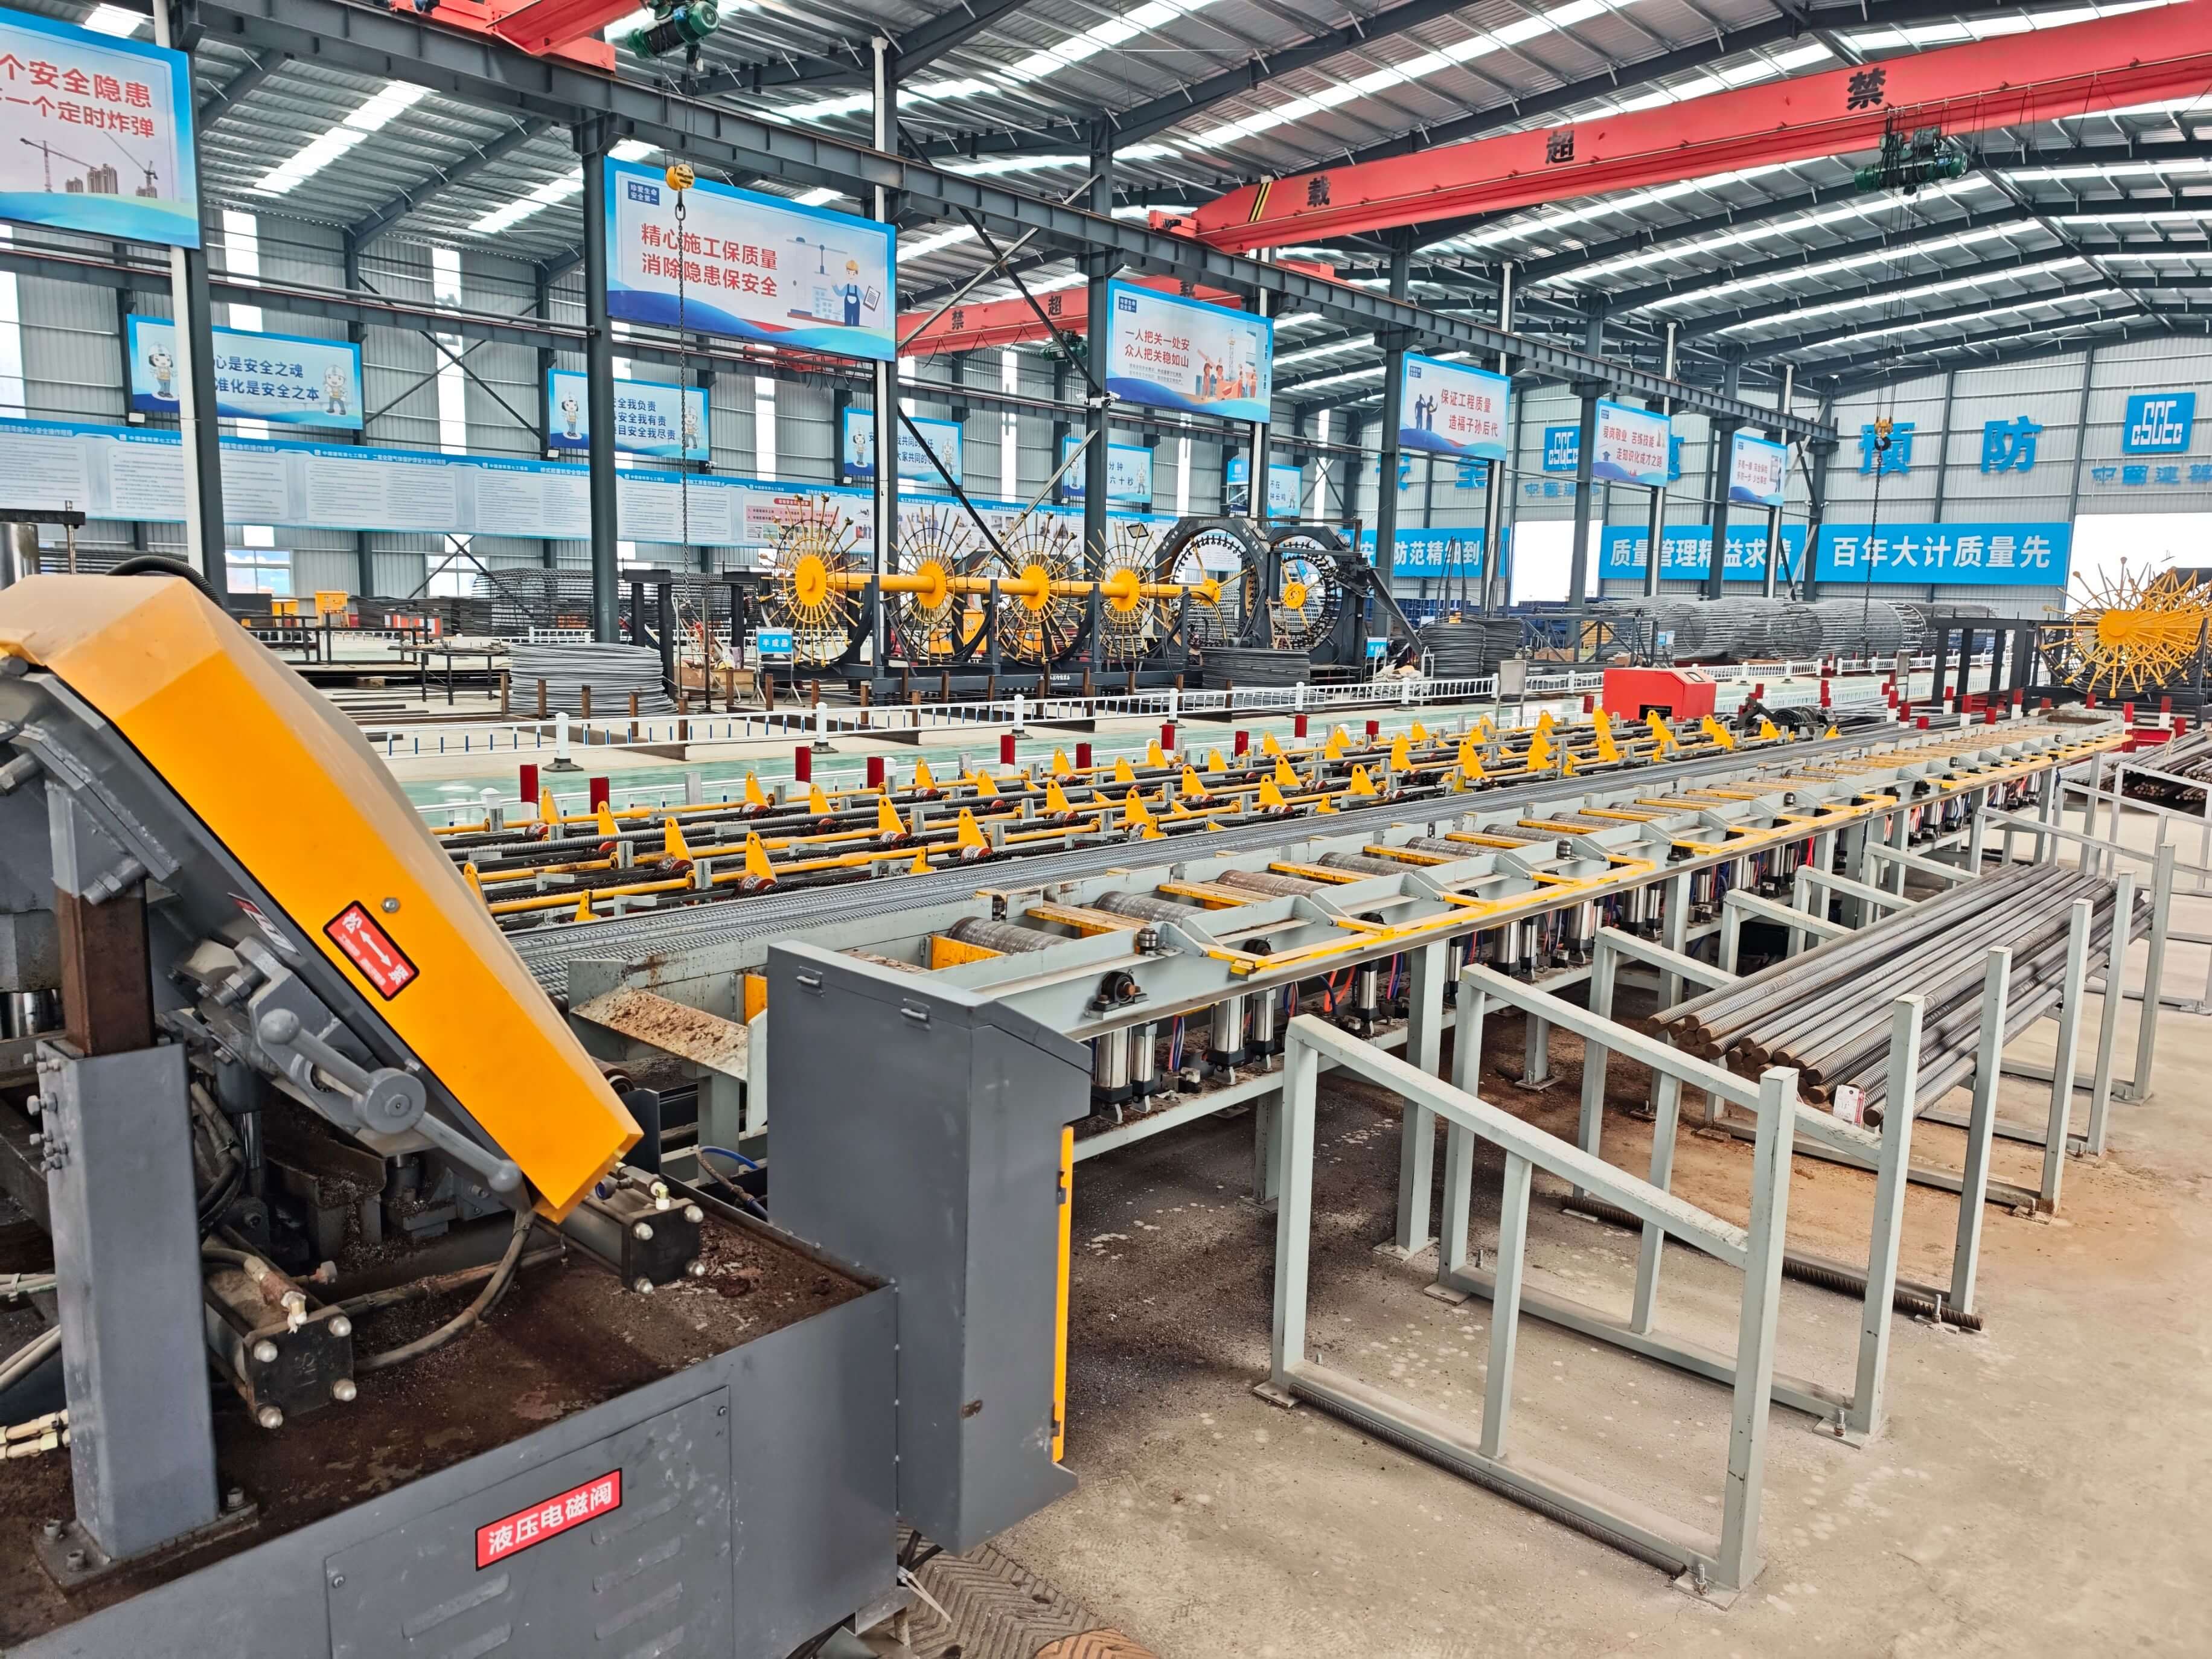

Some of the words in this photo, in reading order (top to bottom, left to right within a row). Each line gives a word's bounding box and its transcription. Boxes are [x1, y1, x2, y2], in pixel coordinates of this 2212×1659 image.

[0, 54, 152, 108] 个安全隐患
[1846, 68, 1887, 111] 禁
[0, 88, 155, 138] 一个定时炸弹
[1546, 130, 1575, 164] 超
[630, 192, 657, 202] 安全第一
[641, 223, 778, 270] 精心施工保质量
[642, 252, 778, 297] 消除隐患保安全
[1047, 295, 1063, 316] 超
[951, 310, 964, 330] 禁
[1125, 328, 1190, 351] 一人把关一处安
[1125, 344, 1189, 368] 众人把关稳如山
[614, 398, 656, 412] 全我负责
[1441, 388, 1492, 413] 保证工程质量
[614, 412, 666, 426] 安全我有责
[1448, 415, 1498, 437] 造福子孙后代
[614, 424, 676, 440] 目安全我尽责
[1832, 535, 2052, 569] 百年大计质量先
[762, 638, 791, 648] 半成品
[342, 912, 363, 935] 松
[388, 964, 409, 986] 紧
[488, 1481, 612, 1556] 液压电磁阀
